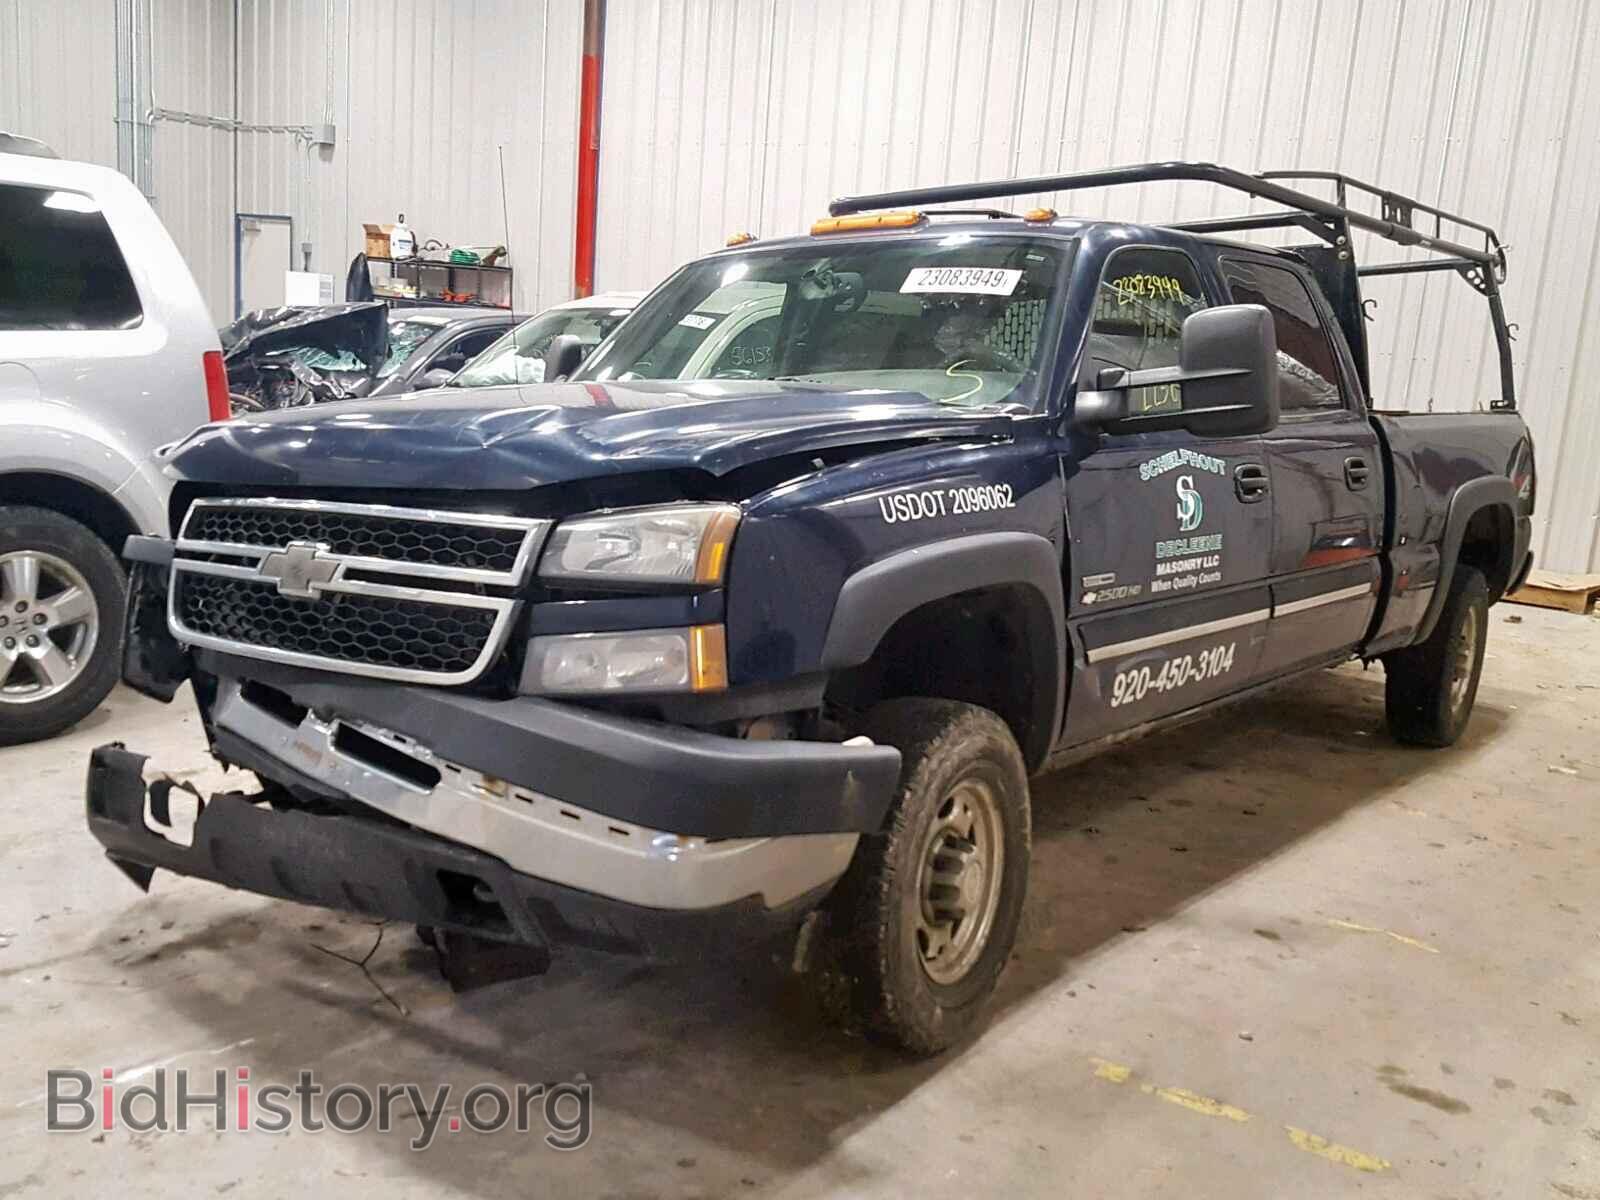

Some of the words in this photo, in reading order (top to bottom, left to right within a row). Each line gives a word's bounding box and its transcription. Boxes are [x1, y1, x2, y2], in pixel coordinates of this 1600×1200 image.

[917, 269, 1005, 288] 23083949
[879, 489, 946, 524] USDOT
[949, 483, 1016, 514] 2096062
[1156, 556, 1201, 576] MASONRY
[1203, 554, 1220, 568] LLC
[1151, 579, 1172, 593] When
[1173, 574, 1198, 590] Quality
[1199, 571, 1222, 584] Counts
[1097, 586, 1128, 602] 2500
[1110, 642, 1236, 708] 920-450-3104
